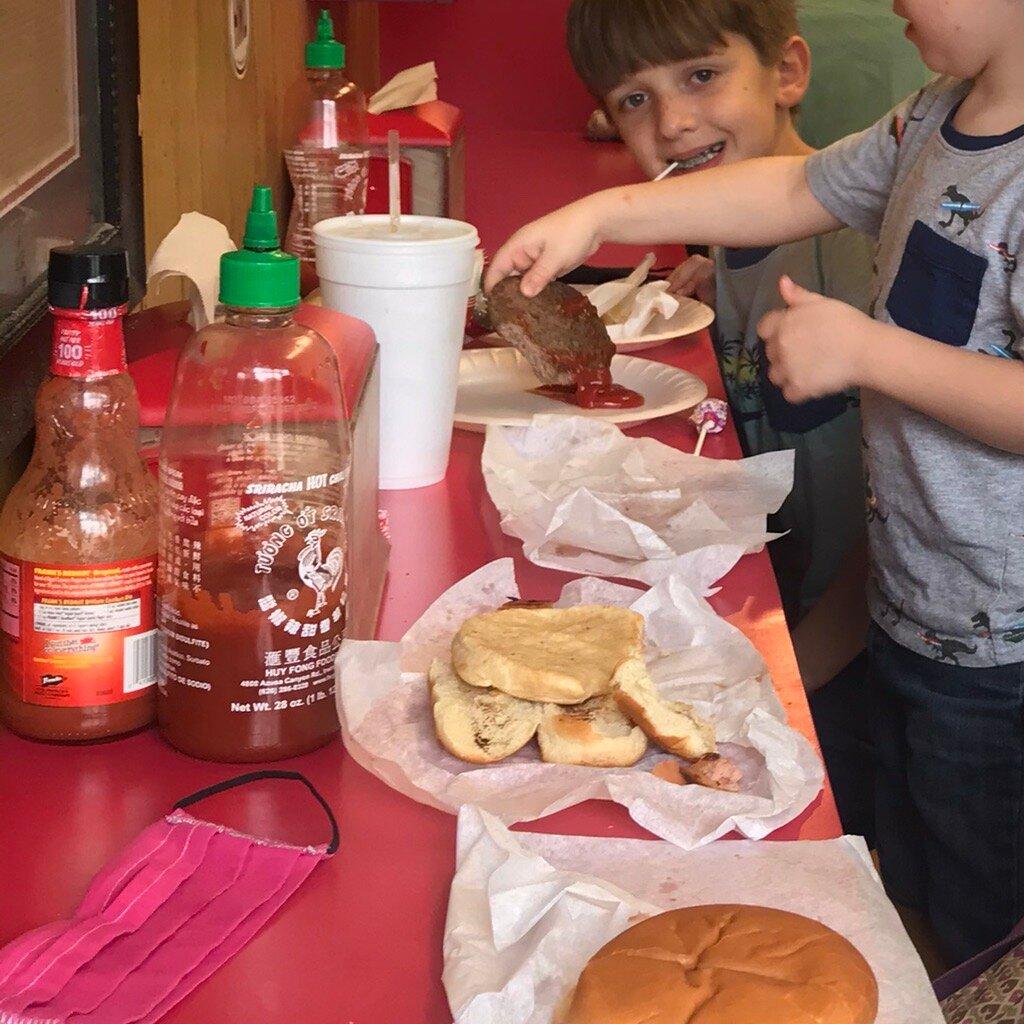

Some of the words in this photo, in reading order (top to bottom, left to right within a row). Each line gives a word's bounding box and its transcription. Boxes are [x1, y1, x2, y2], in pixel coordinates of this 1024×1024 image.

[57, 343, 84, 360] 100
[245, 481, 304, 495] SRIRACHA
[306, 473, 329, 491] HOT
[265, 666, 288, 678] HUY
[288, 660, 315, 676] FONG
[230, 702, 251, 713] Net
[252, 701, 272, 712] Wt.
[273, 699, 288, 711] 28
[289, 697, 306, 709] oz.
